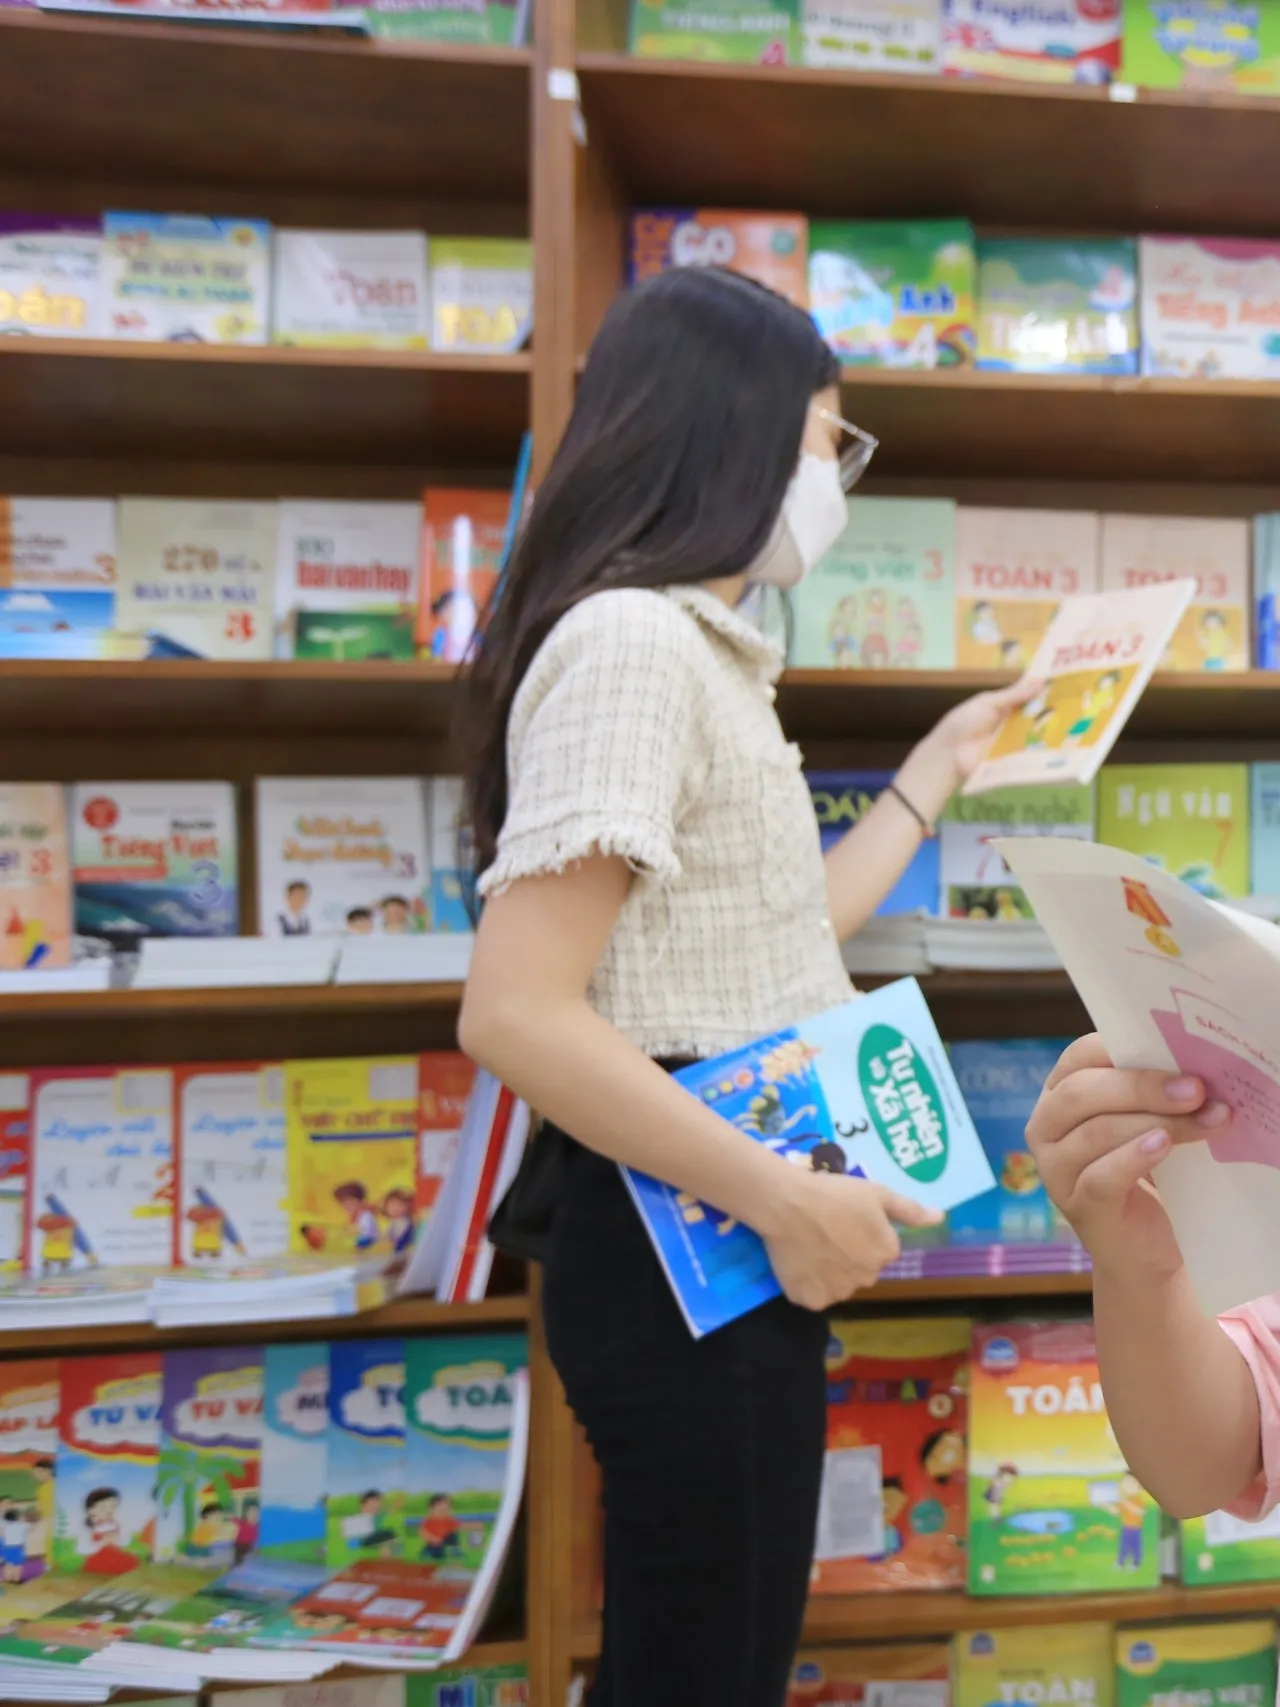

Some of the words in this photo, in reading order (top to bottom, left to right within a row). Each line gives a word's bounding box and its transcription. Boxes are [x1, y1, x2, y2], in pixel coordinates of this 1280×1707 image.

[923, 549, 945, 582] 3
[1060, 566, 1079, 593] 3
[887, 1039, 915, 1082] Tự
[834, 1117, 870, 1140] 3
[900, 1080, 945, 1160] nhiên
[887, 1119, 926, 1170] hội
